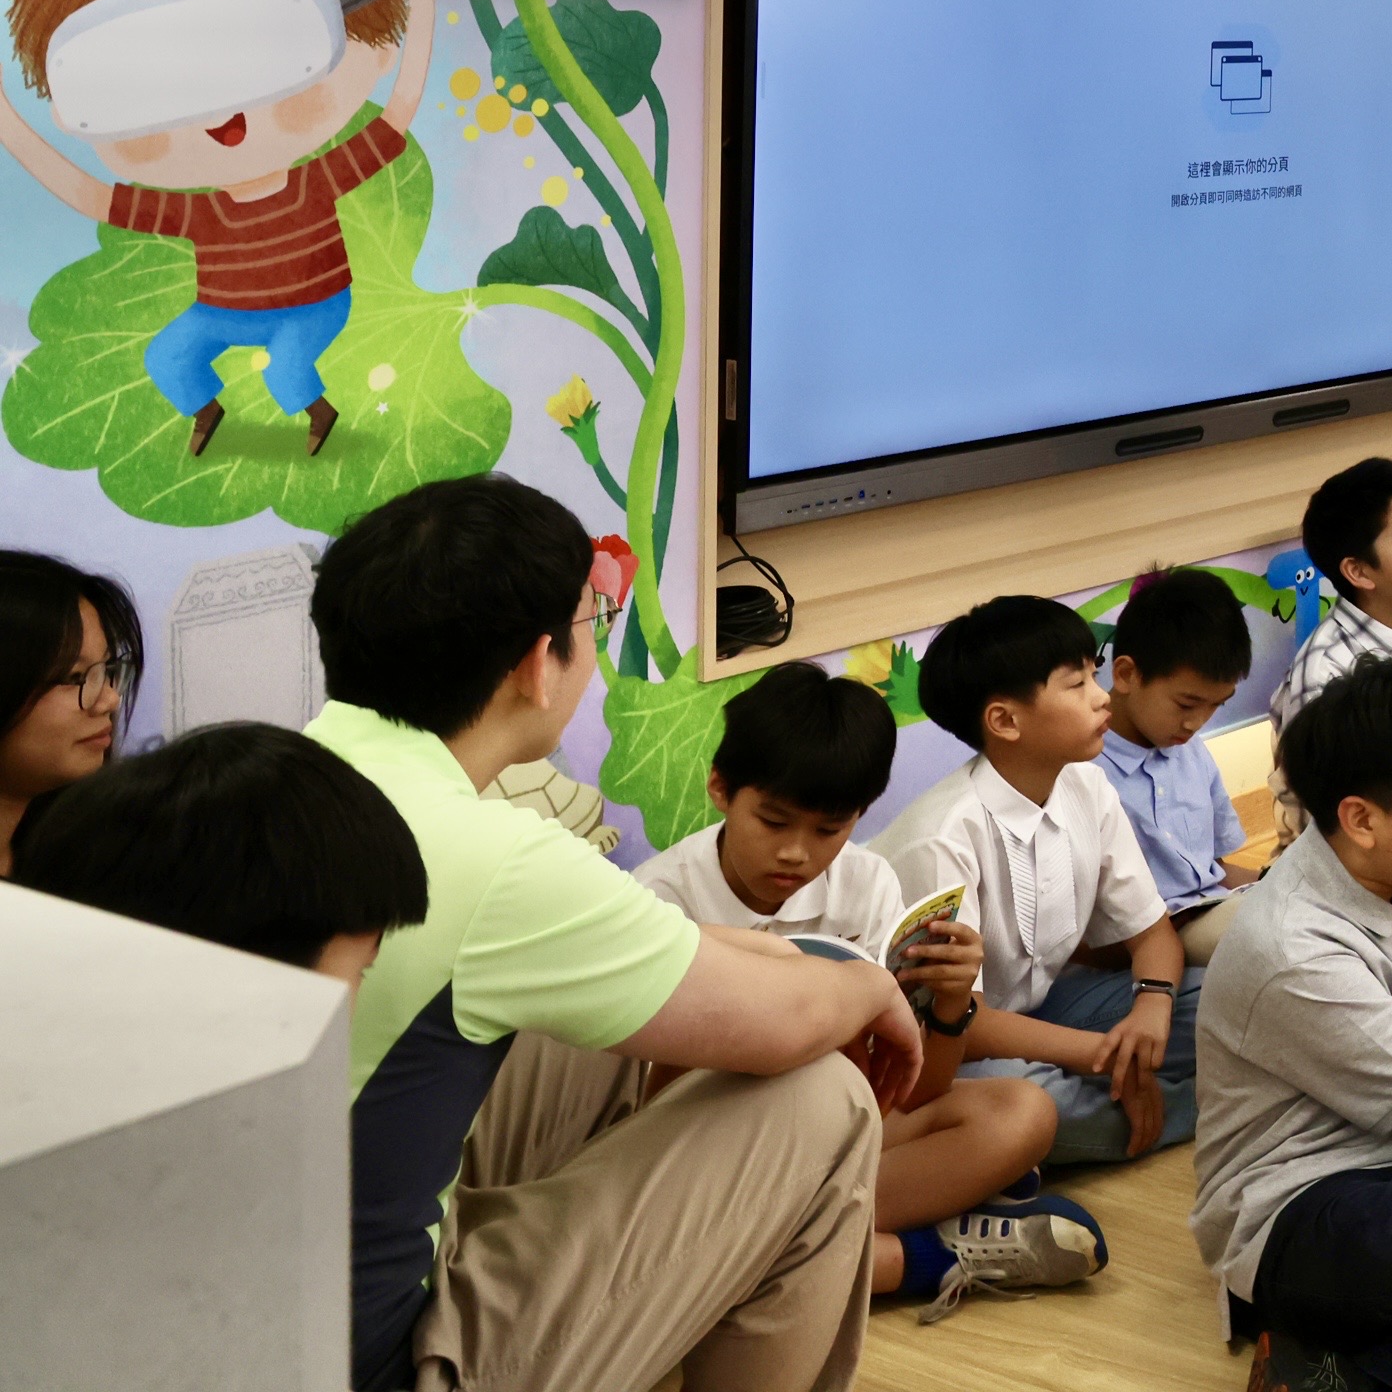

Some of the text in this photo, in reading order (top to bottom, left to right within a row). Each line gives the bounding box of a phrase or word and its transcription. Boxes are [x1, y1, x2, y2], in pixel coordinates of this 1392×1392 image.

[1187, 156, 1289, 179] 這裡會顯示你的分頁
